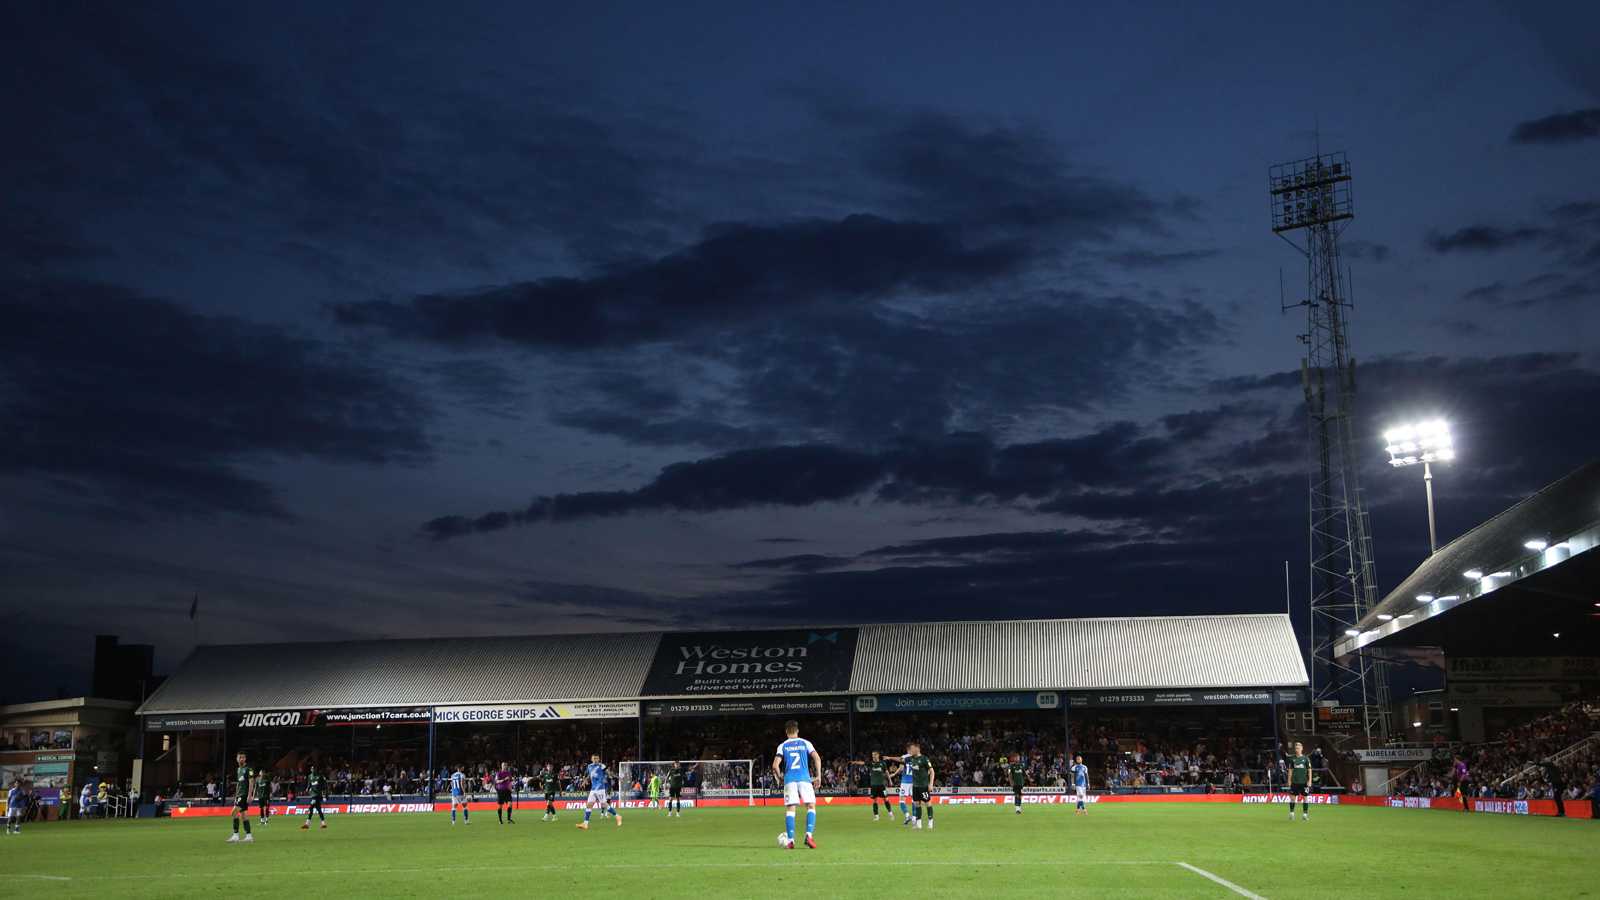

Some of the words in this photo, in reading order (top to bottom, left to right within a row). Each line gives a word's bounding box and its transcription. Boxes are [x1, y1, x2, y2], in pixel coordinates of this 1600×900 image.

[679, 645, 808, 660] Weston
[674, 660, 803, 675] Homes
[686, 683, 740, 691] delivered
[770, 682, 804, 690] pride.
[1203, 692, 1270, 701] weston-homes.com
[761, 702, 823, 710] weston-homes.com
[895, 698, 915, 708] Join
[917, 699, 931, 707] us:
[304, 710, 320, 725] 17
[326, 711, 431, 722] www.junction17cars.co.uk
[434, 711, 460, 721] MICK
[462, 709, 504, 720] GEORGE
[506, 708, 537, 719] SKIPS
[165, 719, 225, 727] weston-homes.com
[1398, 749, 1425, 757] GLOVES
[790, 752, 801, 770] 2
[452, 779, 460, 789] 11
[1060, 795, 1100, 804] DRNK
[1242, 795, 1269, 803] NOW
